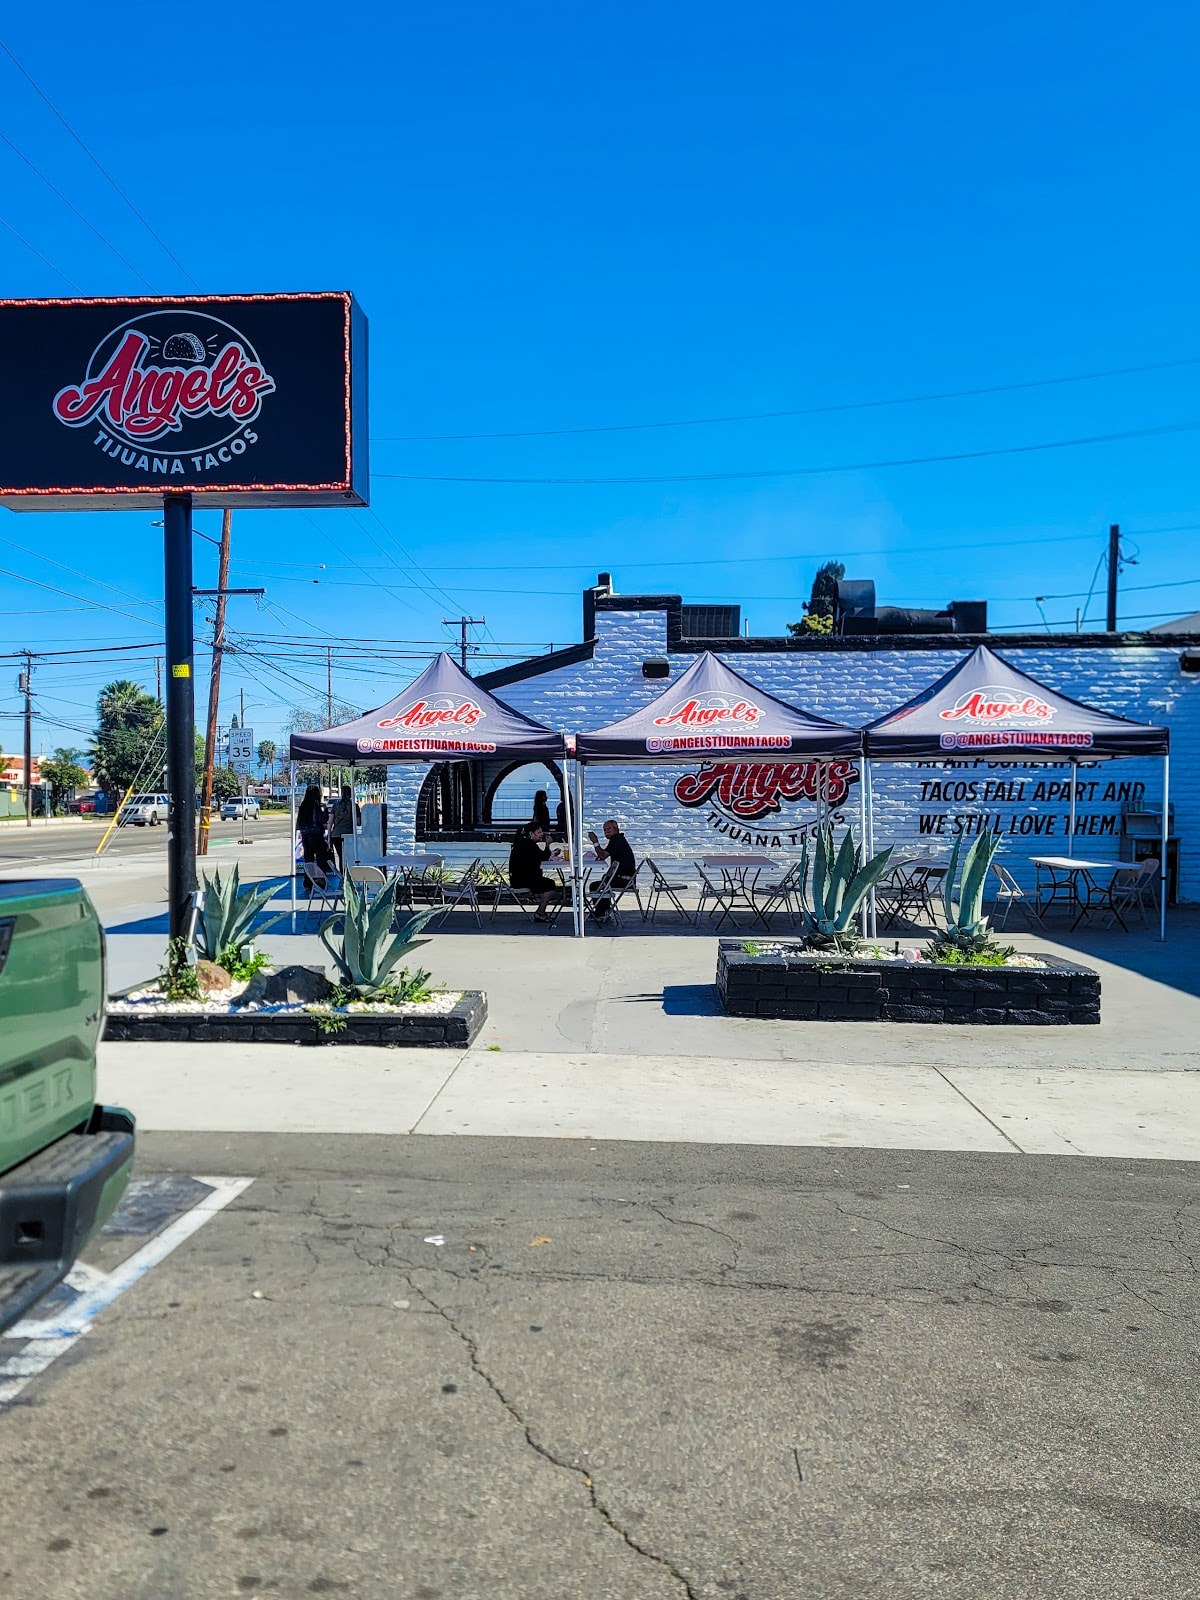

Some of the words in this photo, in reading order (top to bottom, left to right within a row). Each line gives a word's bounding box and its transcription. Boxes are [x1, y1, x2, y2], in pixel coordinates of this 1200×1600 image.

[53, 329, 276, 441] Angel's
[93, 430, 185, 474] TIJUANA
[191, 428, 258, 472] TACOS
[377, 700, 487, 729] Angel's
[653, 699, 767, 728] Angel's
[939, 692, 1058, 720] Angel's
[232, 747, 251, 758] 35
[663, 736, 791, 750] @ANGELSTIJUANATACOS
[957, 733, 1092, 748] @ANGELSTIJUANATACOS
[919, 782, 978, 801] TACOS
[984, 782, 1025, 801] FALL
[1033, 782, 1099, 801] APART
[1103, 782, 1146, 801] AND
[705, 811, 782, 848] TIJUANA
[919, 815, 945, 835] WE
[1010, 815, 1057, 835] LOVE
